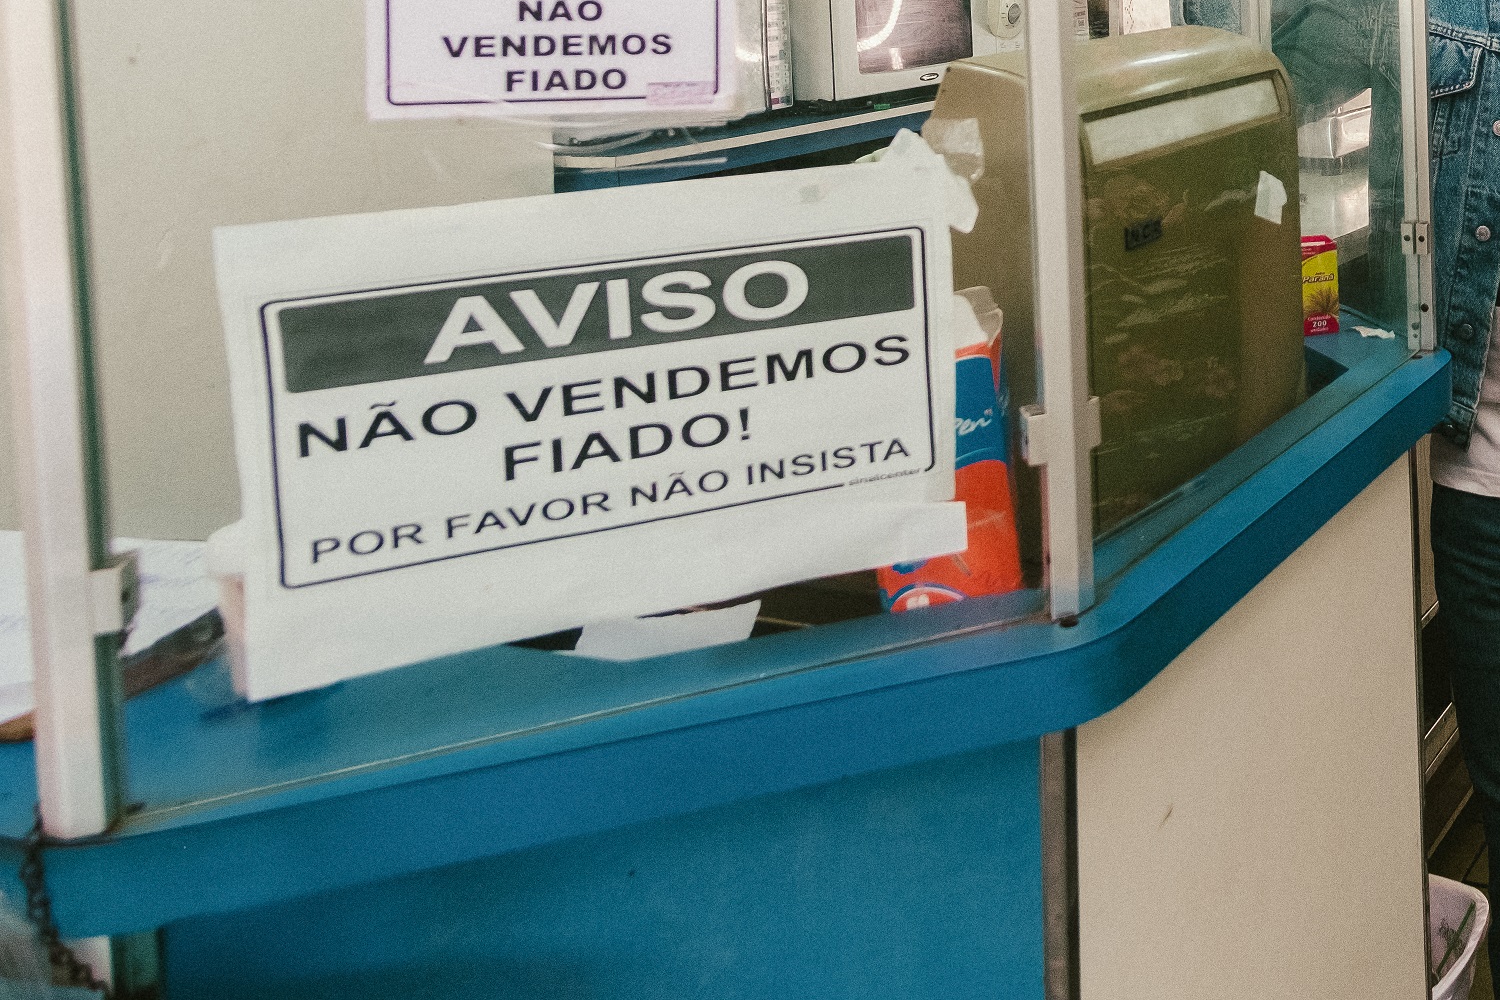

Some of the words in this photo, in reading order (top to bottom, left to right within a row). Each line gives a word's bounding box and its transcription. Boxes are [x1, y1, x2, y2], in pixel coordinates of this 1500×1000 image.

[443, 34, 673, 59] VENDEMOS
[505, 68, 627, 93] FIADO
[1302, 272, 1335, 284] Paraná
[424, 260, 810, 365] AVISO
[1312, 319, 1327, 328] 200
[297, 400, 479, 459] NÃO
[504, 334, 912, 425] VENDEMOS
[502, 408, 754, 483] FIADO!
[311, 522, 424, 565] POR
[445, 491, 612, 540] FAVOR
[630, 467, 730, 508] NÃO
[747, 437, 912, 486] INSISTA
